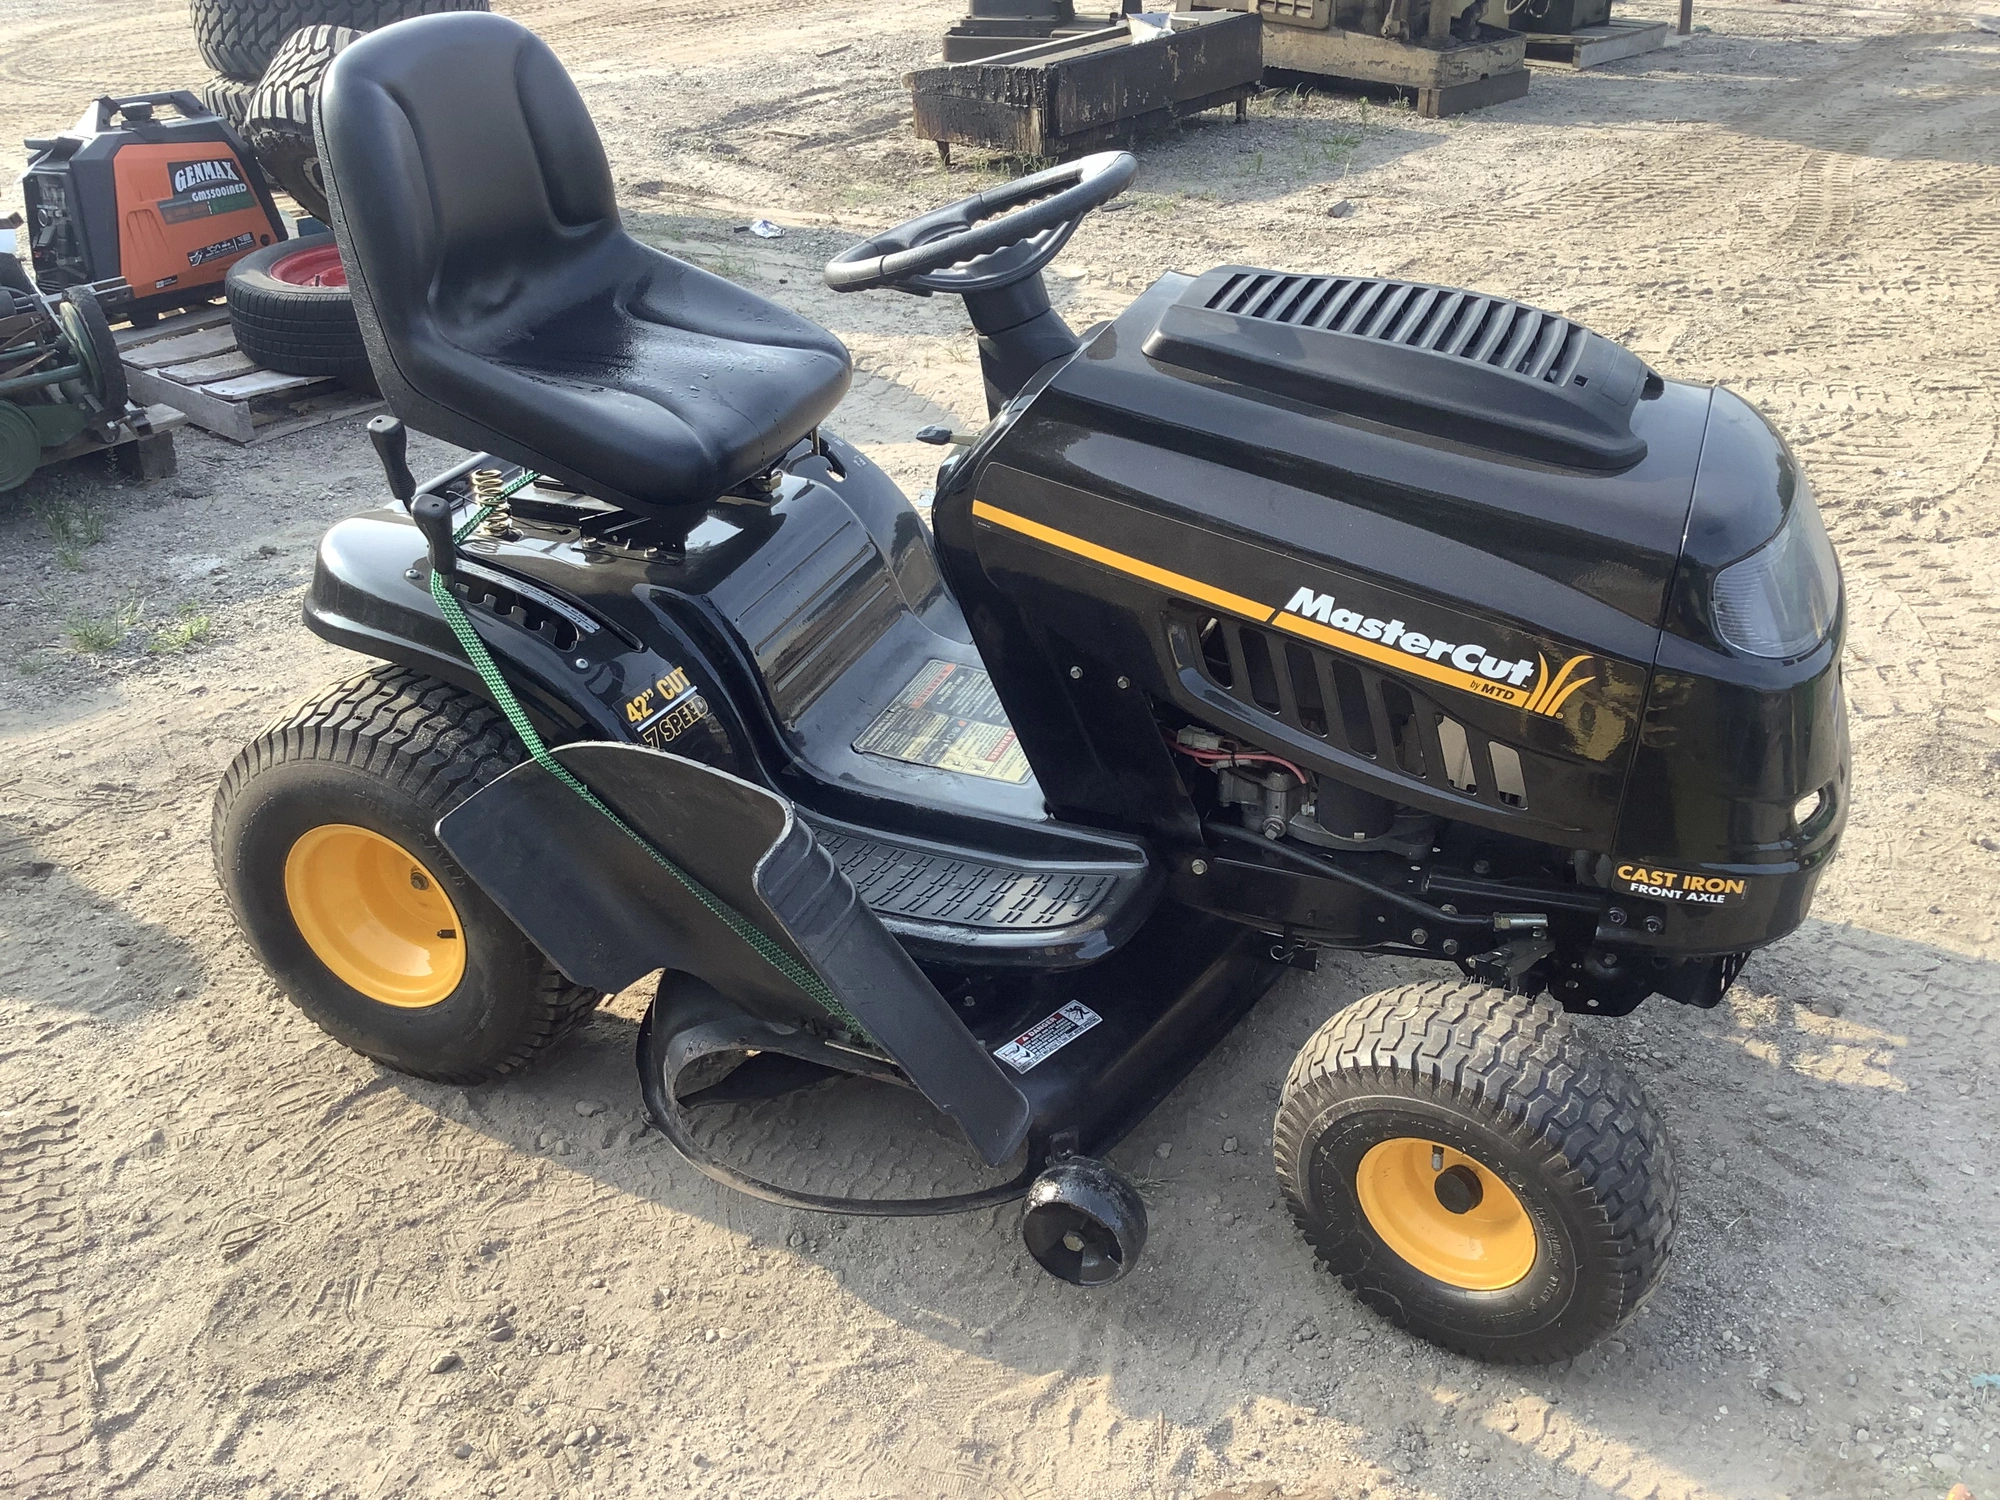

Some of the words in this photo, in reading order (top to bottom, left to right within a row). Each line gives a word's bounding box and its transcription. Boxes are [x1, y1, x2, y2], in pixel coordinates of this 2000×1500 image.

[175, 161, 239, 192] GENMAX
[1284, 586, 1534, 686] MasterCut
[656, 665, 691, 700] CUT
[1470, 680, 1480, 690] by
[1481, 683, 1515, 700] MTD
[642, 726, 660, 749] 7
[659, 695, 708, 742] SPEED
[986, 735, 1013, 760] DANGER
[1617, 865, 1677, 887] CAST
[1682, 875, 1745, 894] IRON
[1630, 882, 1683, 899] FRONT
[1686, 891, 1726, 904] AXLE
[1026, 1016, 1058, 1037] DANGER
